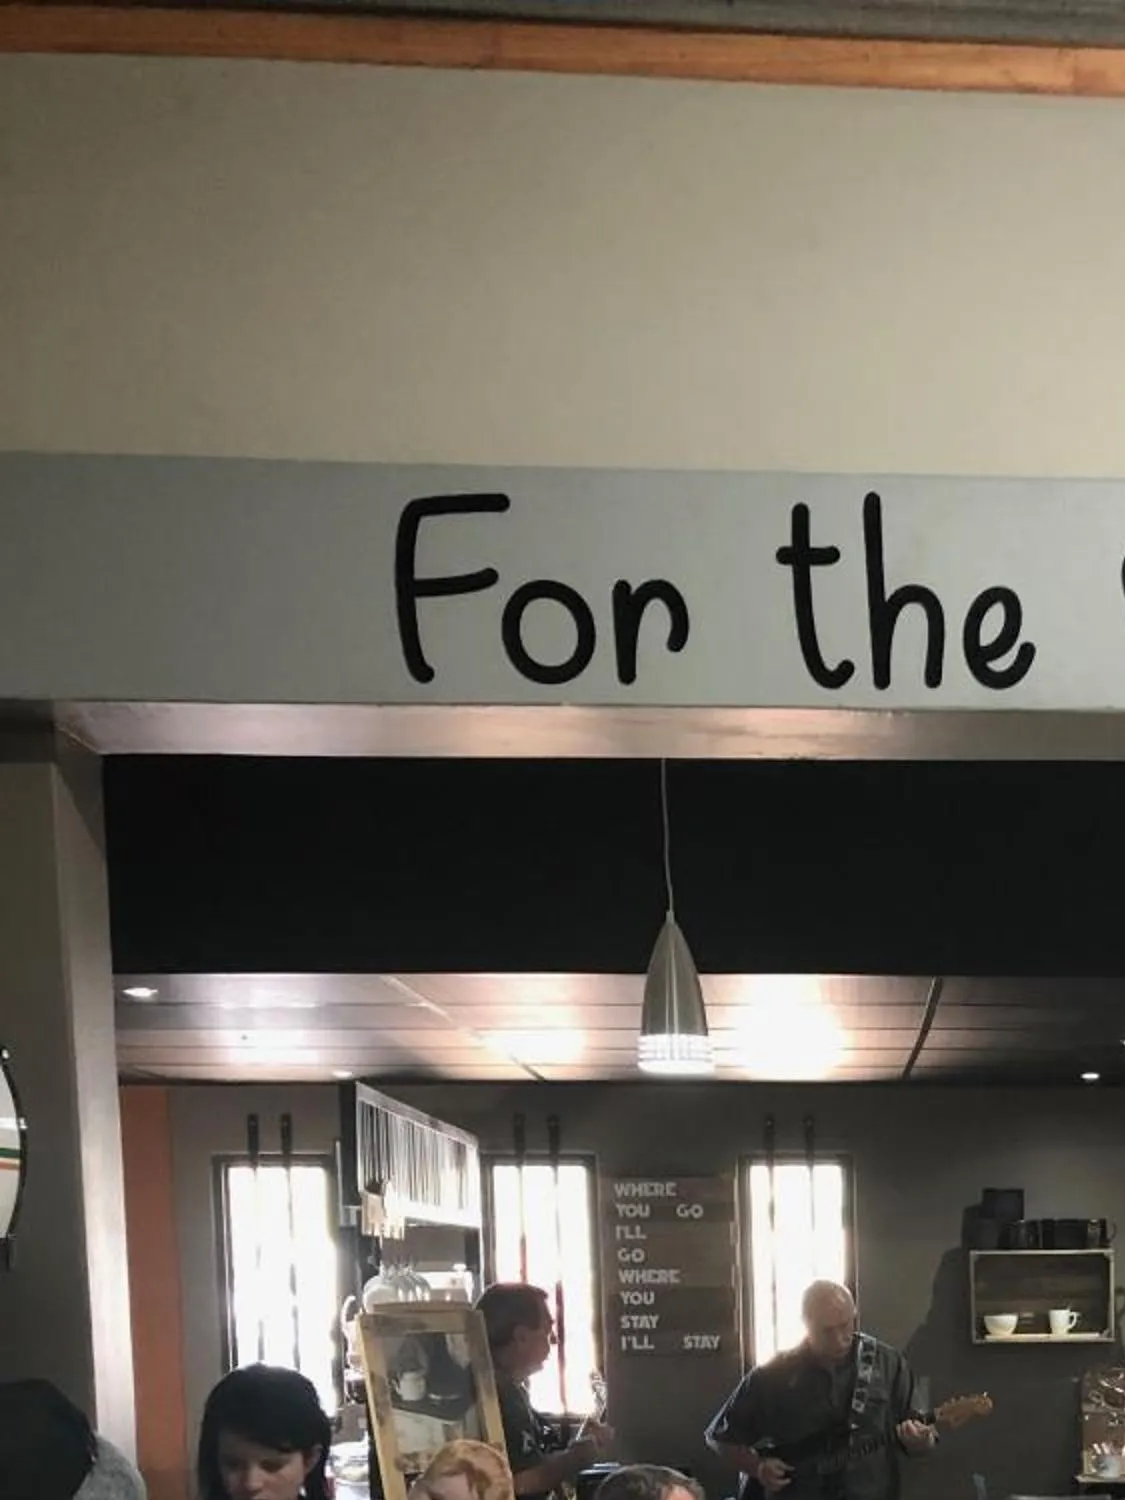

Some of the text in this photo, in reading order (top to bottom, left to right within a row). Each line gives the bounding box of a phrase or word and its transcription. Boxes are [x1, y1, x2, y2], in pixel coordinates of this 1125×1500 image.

[395, 492, 689, 685] For
[776, 491, 1036, 690] the
[614, 1182, 677, 1197] WHERE
[616, 1203, 704, 1219] YOU GO
[616, 1225, 647, 1240] I'LL
[617, 1248, 645, 1263] GO
[618, 1269, 681, 1284] WHERE
[620, 1290, 655, 1305] YOU
[620, 1315, 659, 1329] STAY
[621, 1335, 721, 1350] I'LL STAY
